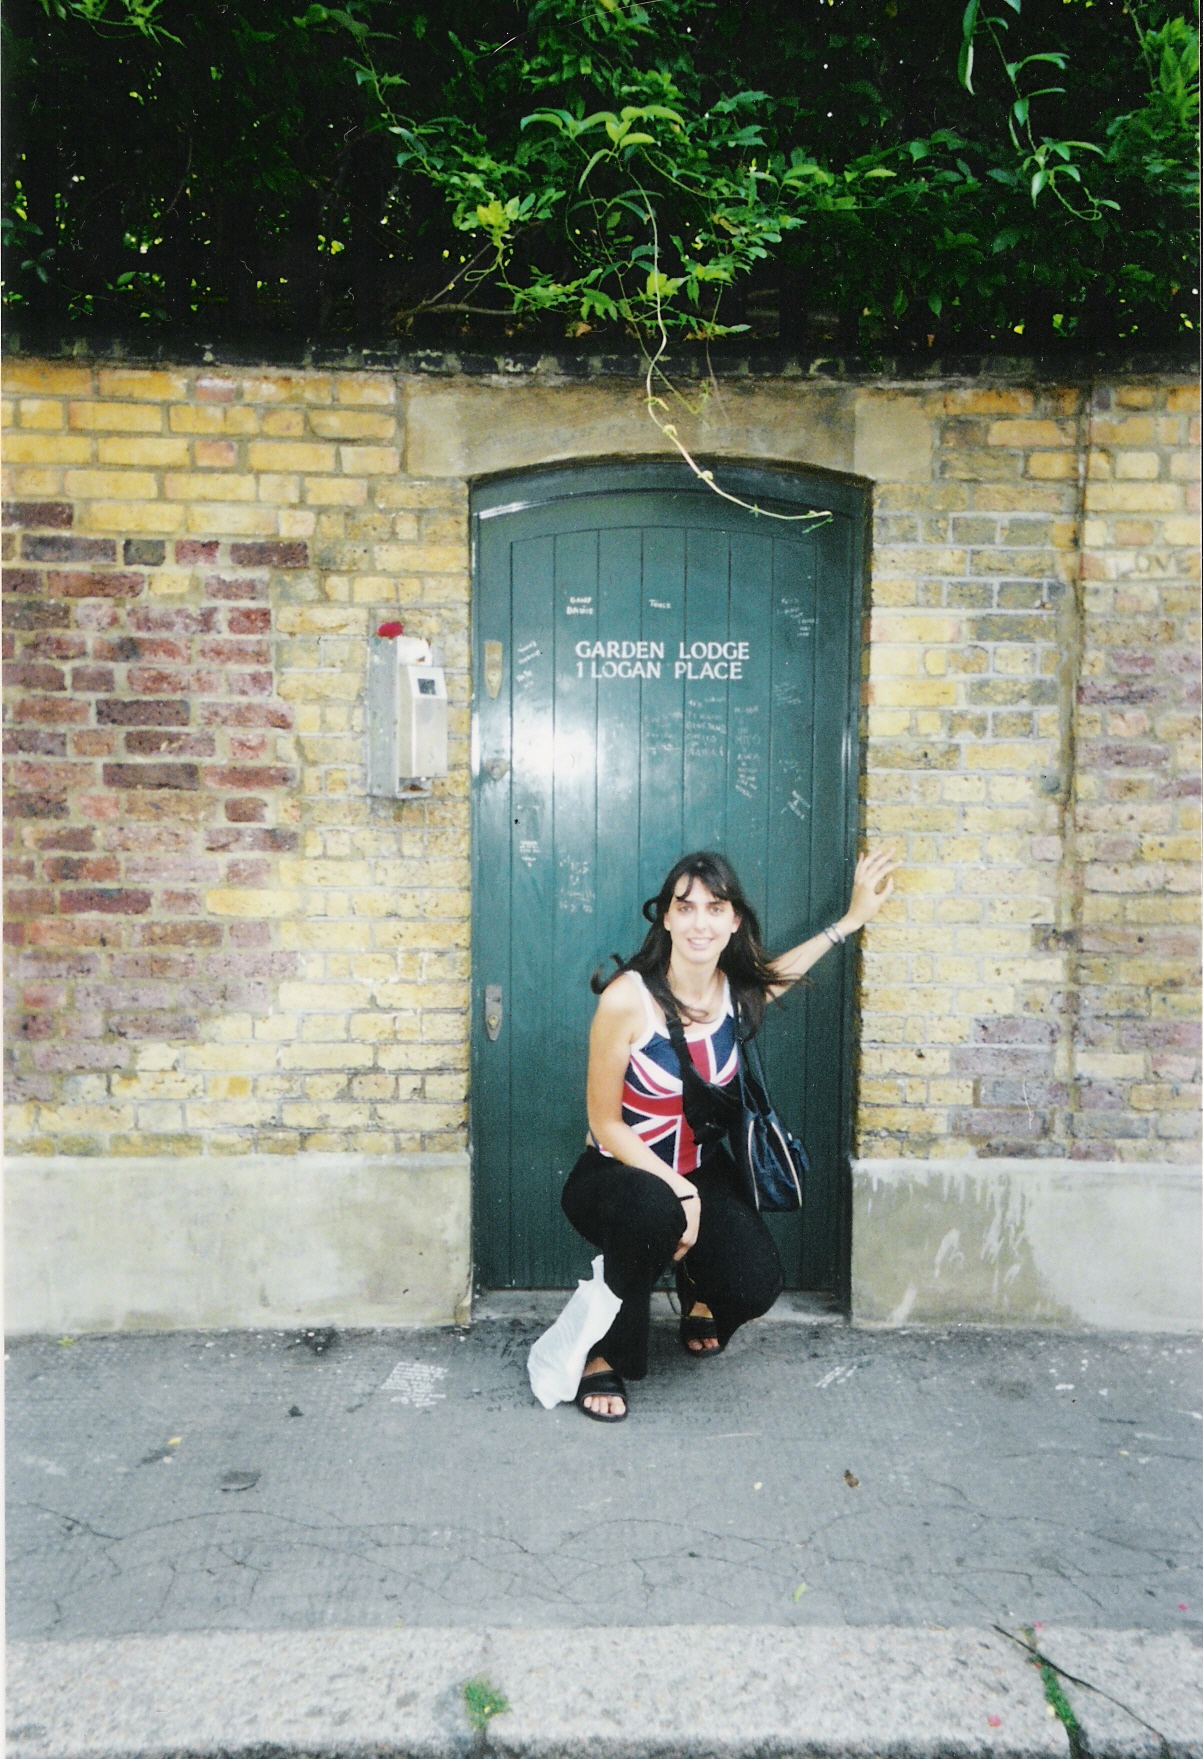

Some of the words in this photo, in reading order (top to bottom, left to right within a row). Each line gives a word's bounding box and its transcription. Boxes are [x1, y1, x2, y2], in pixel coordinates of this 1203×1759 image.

[575, 641, 665, 659] GARDEN
[679, 642, 750, 660] LODGE
[576, 661, 584, 679] 1
[591, 661, 661, 679] LOGAN
[674, 661, 743, 680] PLACE
